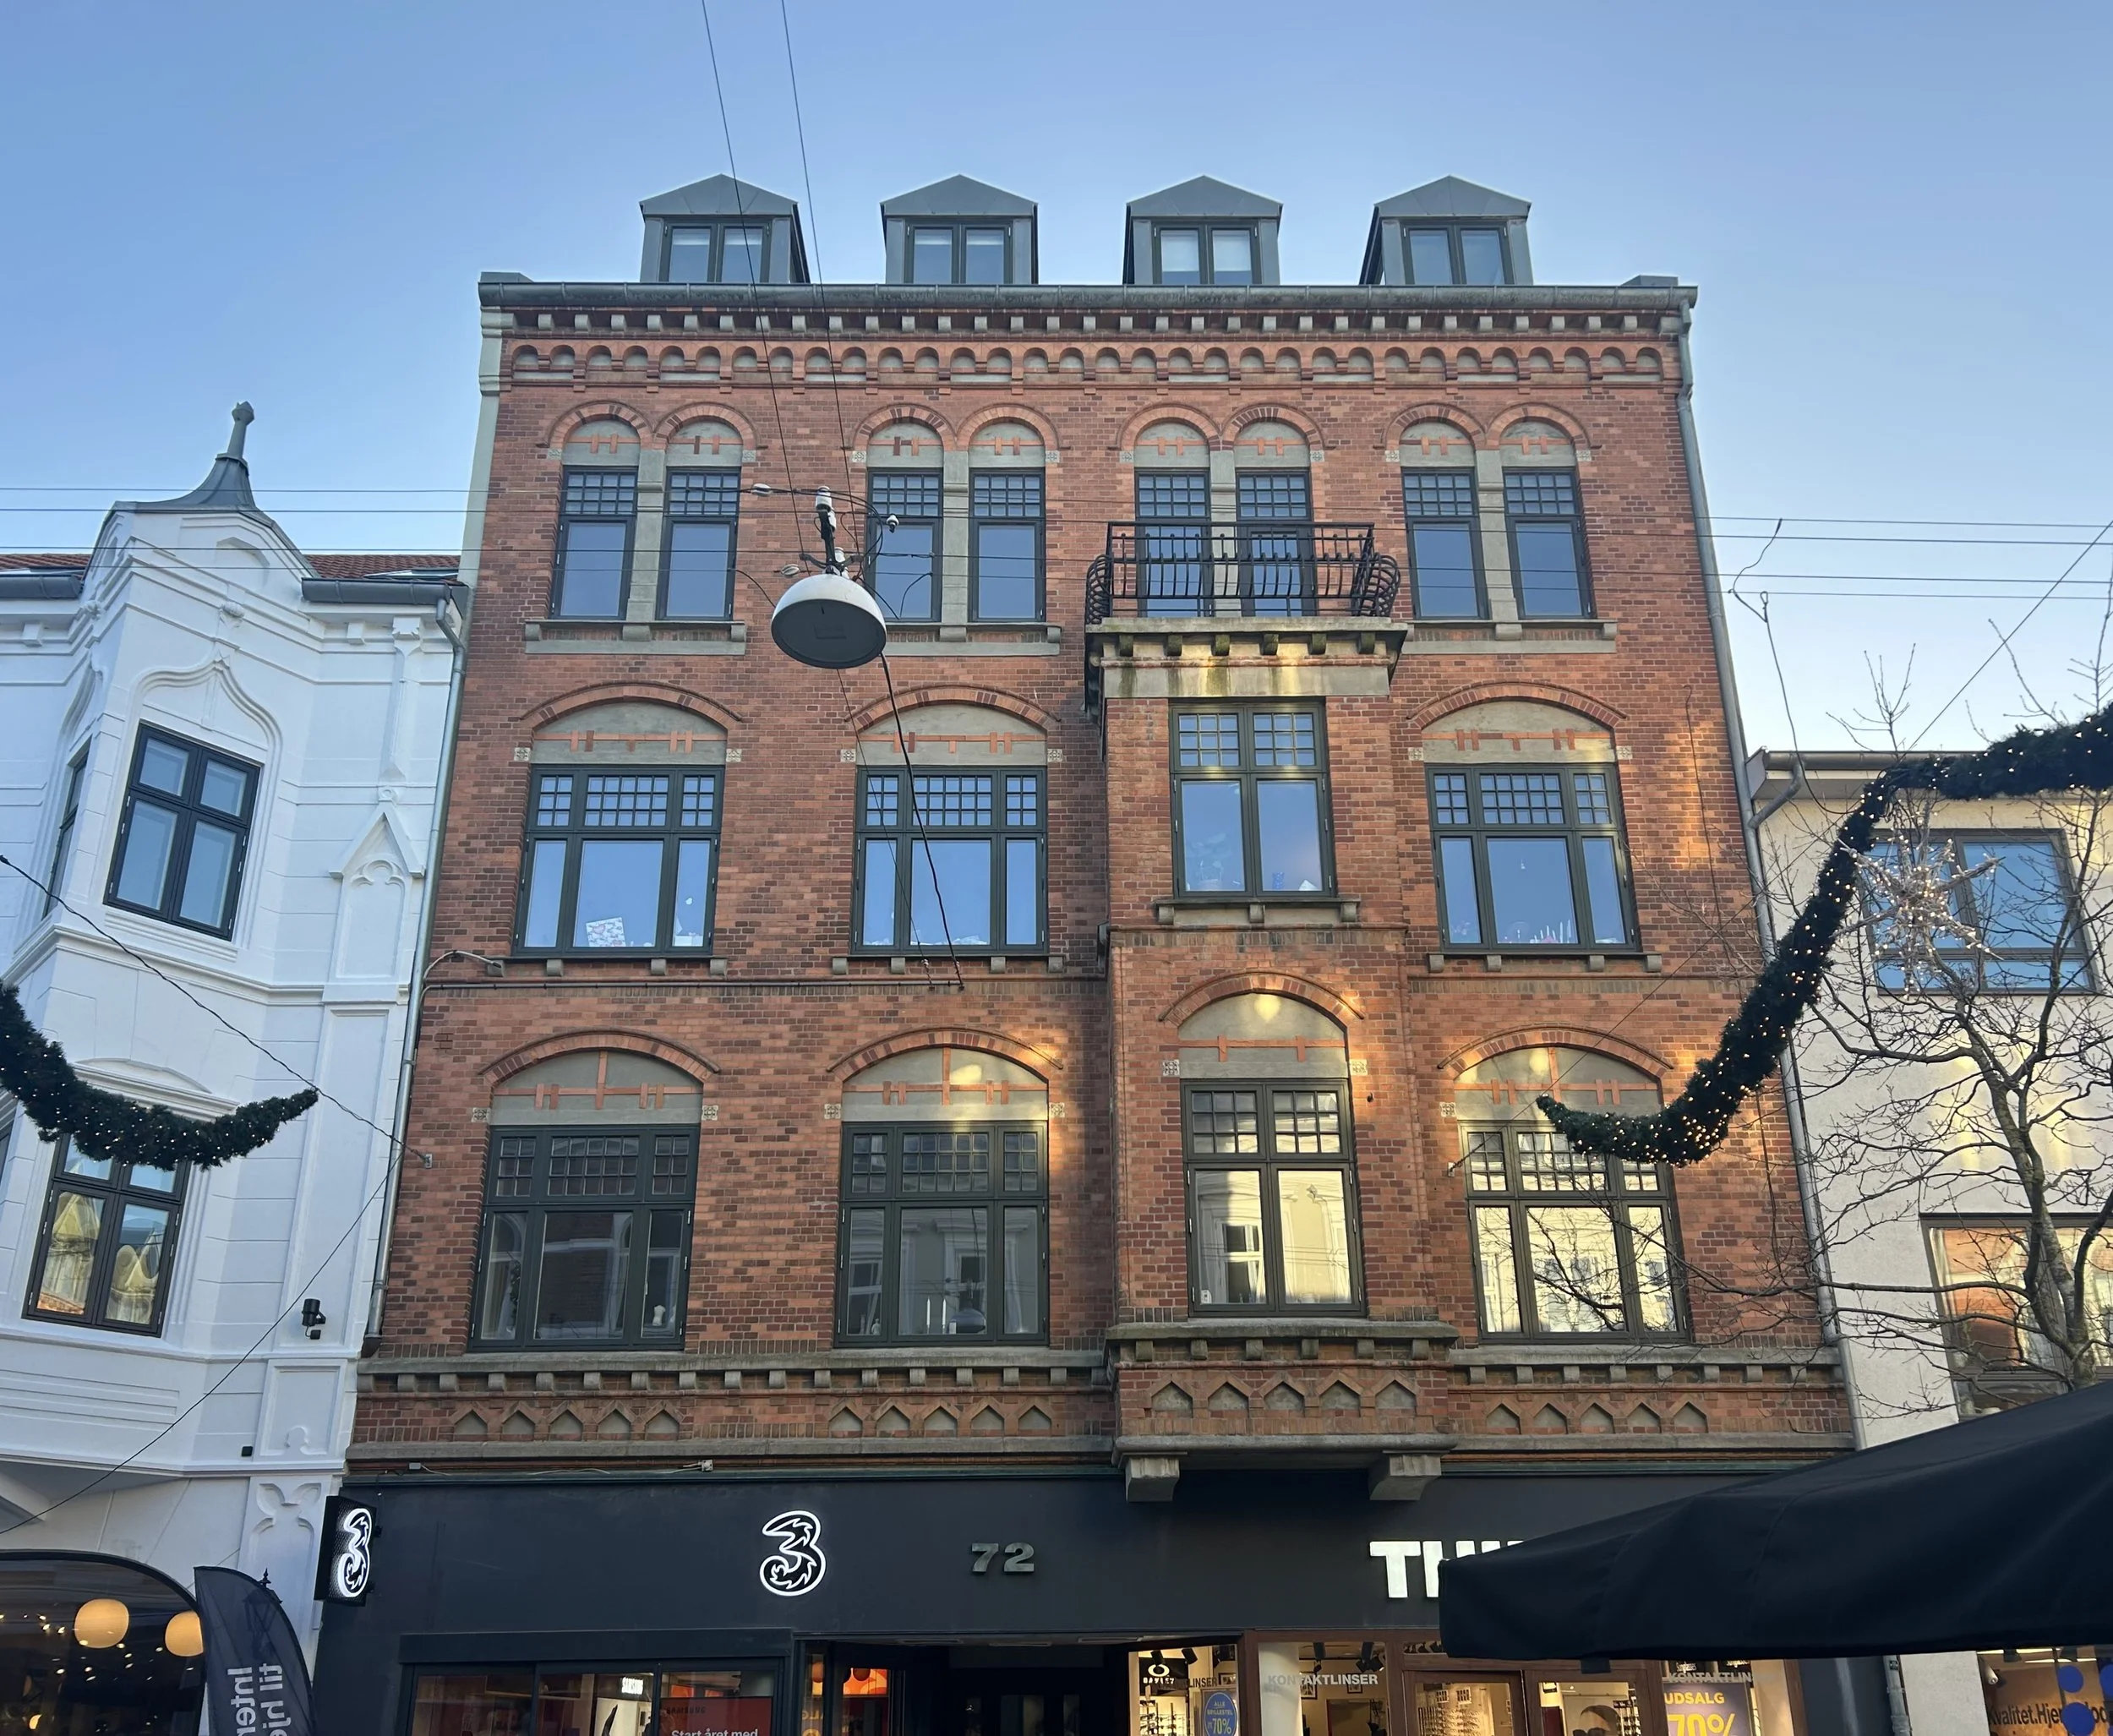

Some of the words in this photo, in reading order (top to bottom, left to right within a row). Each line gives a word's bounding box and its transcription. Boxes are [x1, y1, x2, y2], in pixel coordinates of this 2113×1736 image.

[338, 1508, 372, 1597] 3
[760, 1510, 826, 1596] 3
[971, 1542, 1035, 1572] 72
[1268, 1673, 1379, 1685] KONTAKTLINSER
[1663, 1692, 1725, 1705] UDSALG
[1212, 1717, 1232, 1734] 70%
